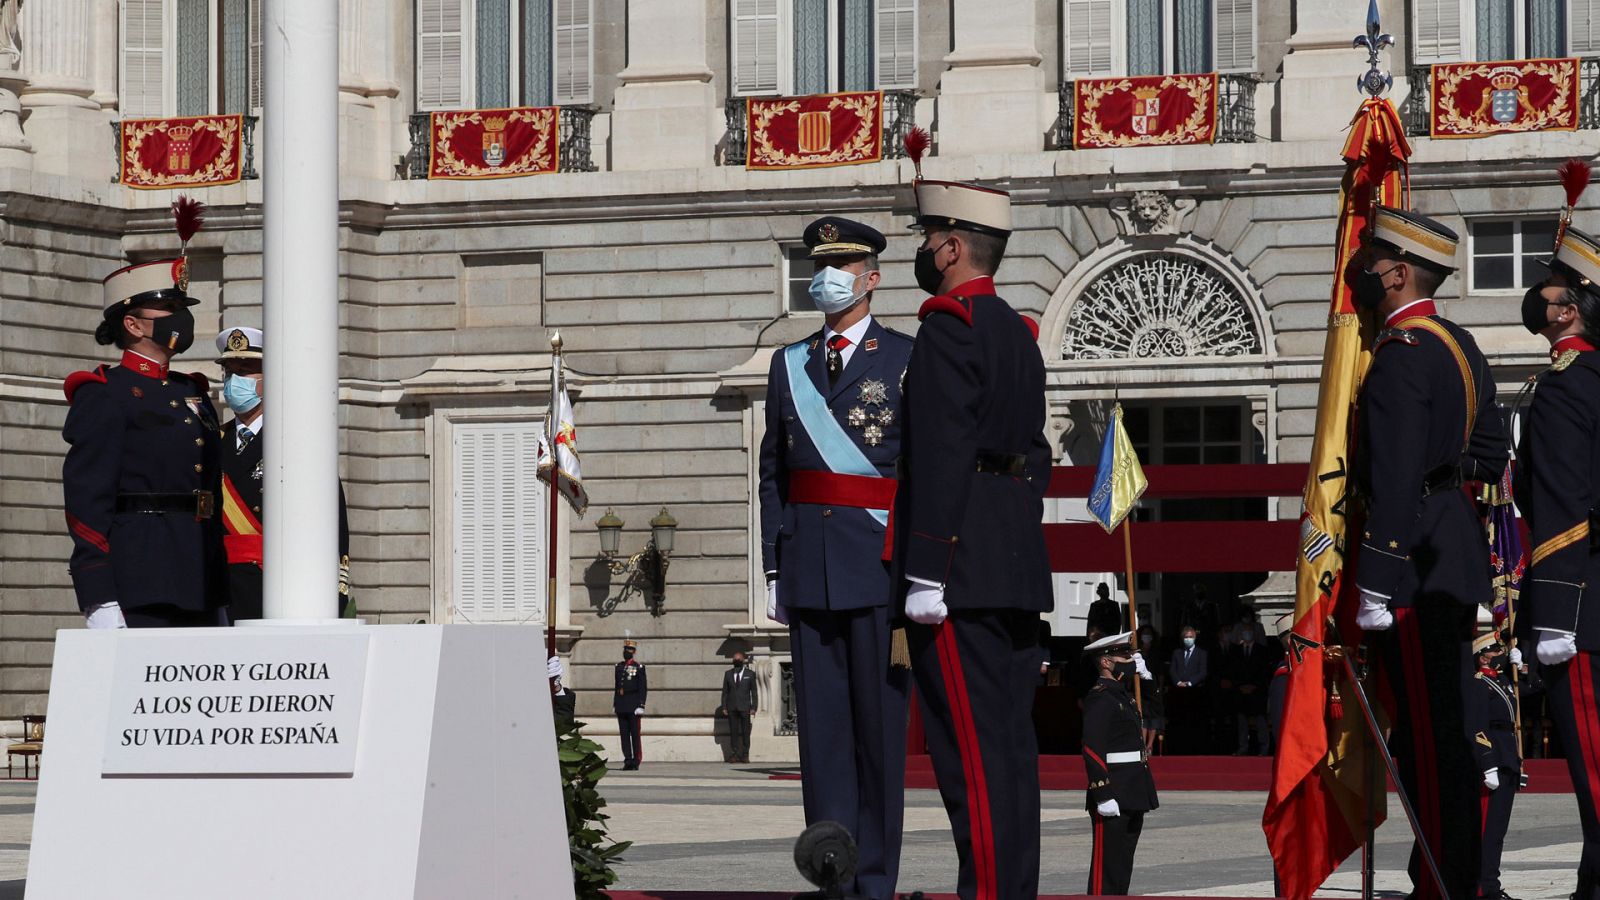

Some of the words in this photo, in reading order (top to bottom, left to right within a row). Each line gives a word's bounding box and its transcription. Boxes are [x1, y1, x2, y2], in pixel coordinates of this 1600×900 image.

[1318, 456, 1348, 598] REAL
[144, 664, 226, 683] HONOR
[231, 663, 246, 681] Y
[248, 662, 331, 682] GLORIA
[132, 697, 147, 715] A
[151, 696, 192, 714] LOS
[197, 695, 243, 719] QUE
[247, 694, 335, 713] DIERON
[121, 728, 149, 747] SU
[152, 727, 205, 746] VIDA
[210, 727, 255, 745] POR
[259, 722, 339, 745] ESPAÑA
